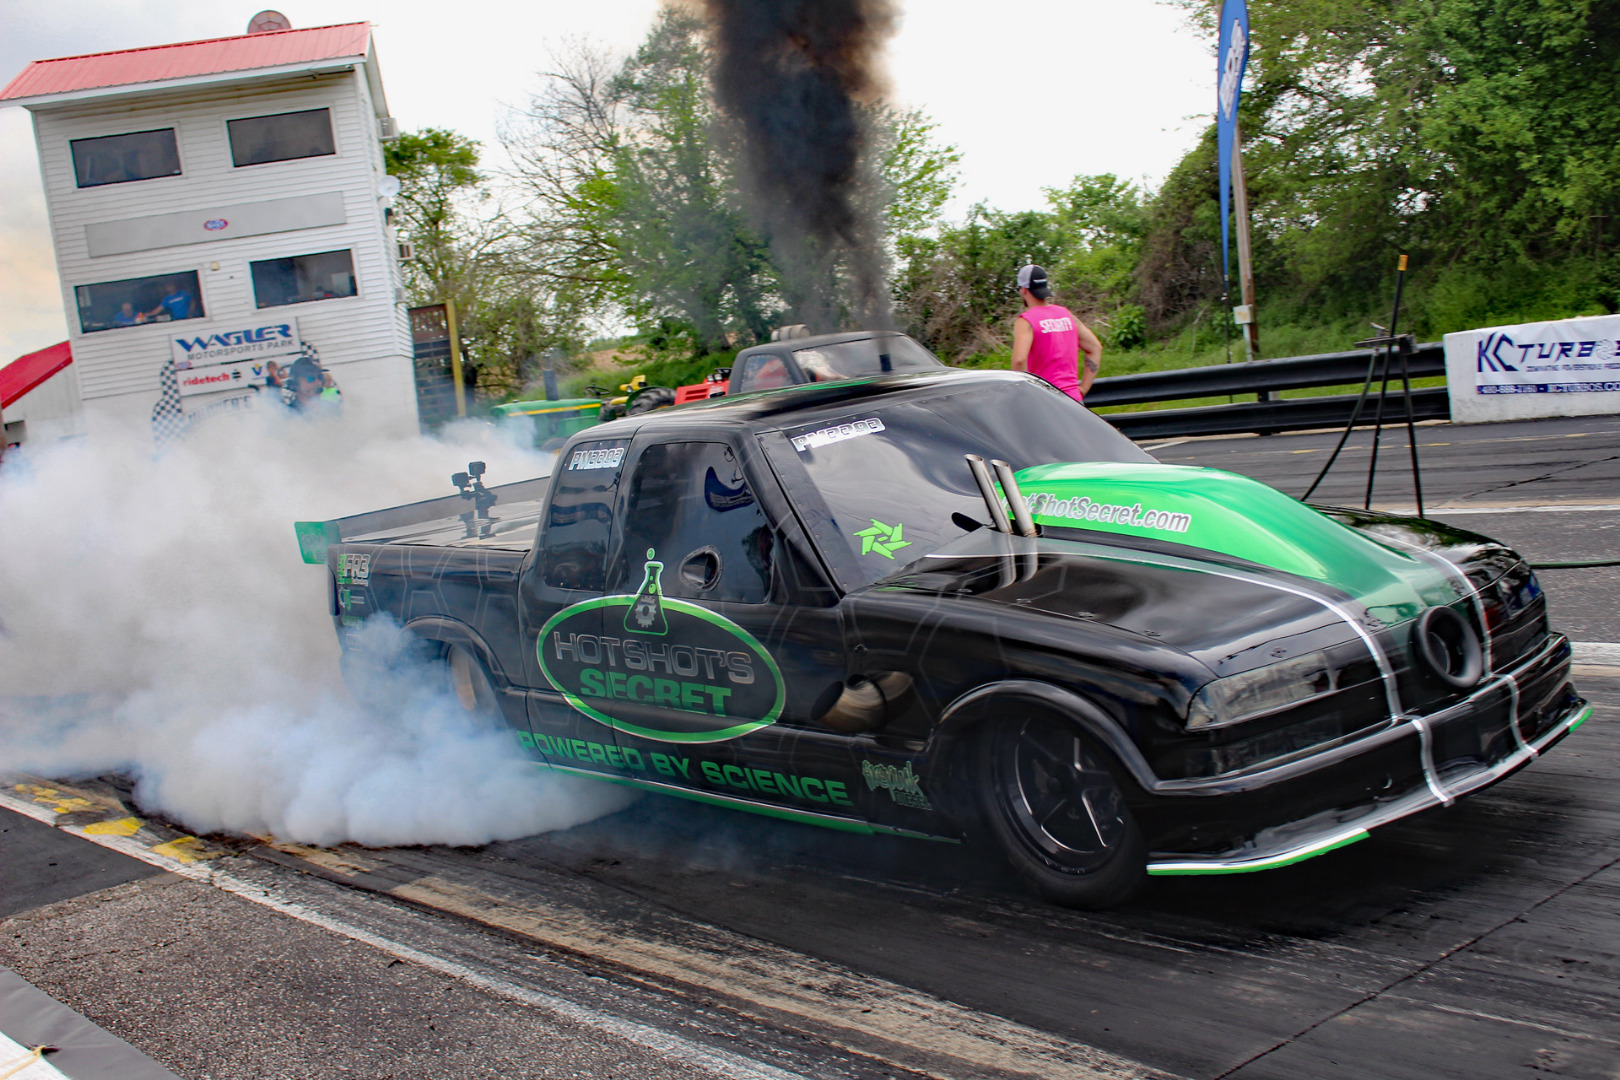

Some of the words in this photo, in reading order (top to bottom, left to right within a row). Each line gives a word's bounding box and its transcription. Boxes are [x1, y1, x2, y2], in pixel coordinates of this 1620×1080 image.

[176, 324, 293, 352] WAGLER
[187, 343, 264, 360] MOTORSPORTS
[267, 339, 294, 349] PARK
[183, 372, 231, 386] ridetech
[579, 668, 732, 717] SECRET
[517, 730, 646, 771] POWERED
[651, 752, 691, 780] BY
[700, 760, 855, 806] SCIENCE
